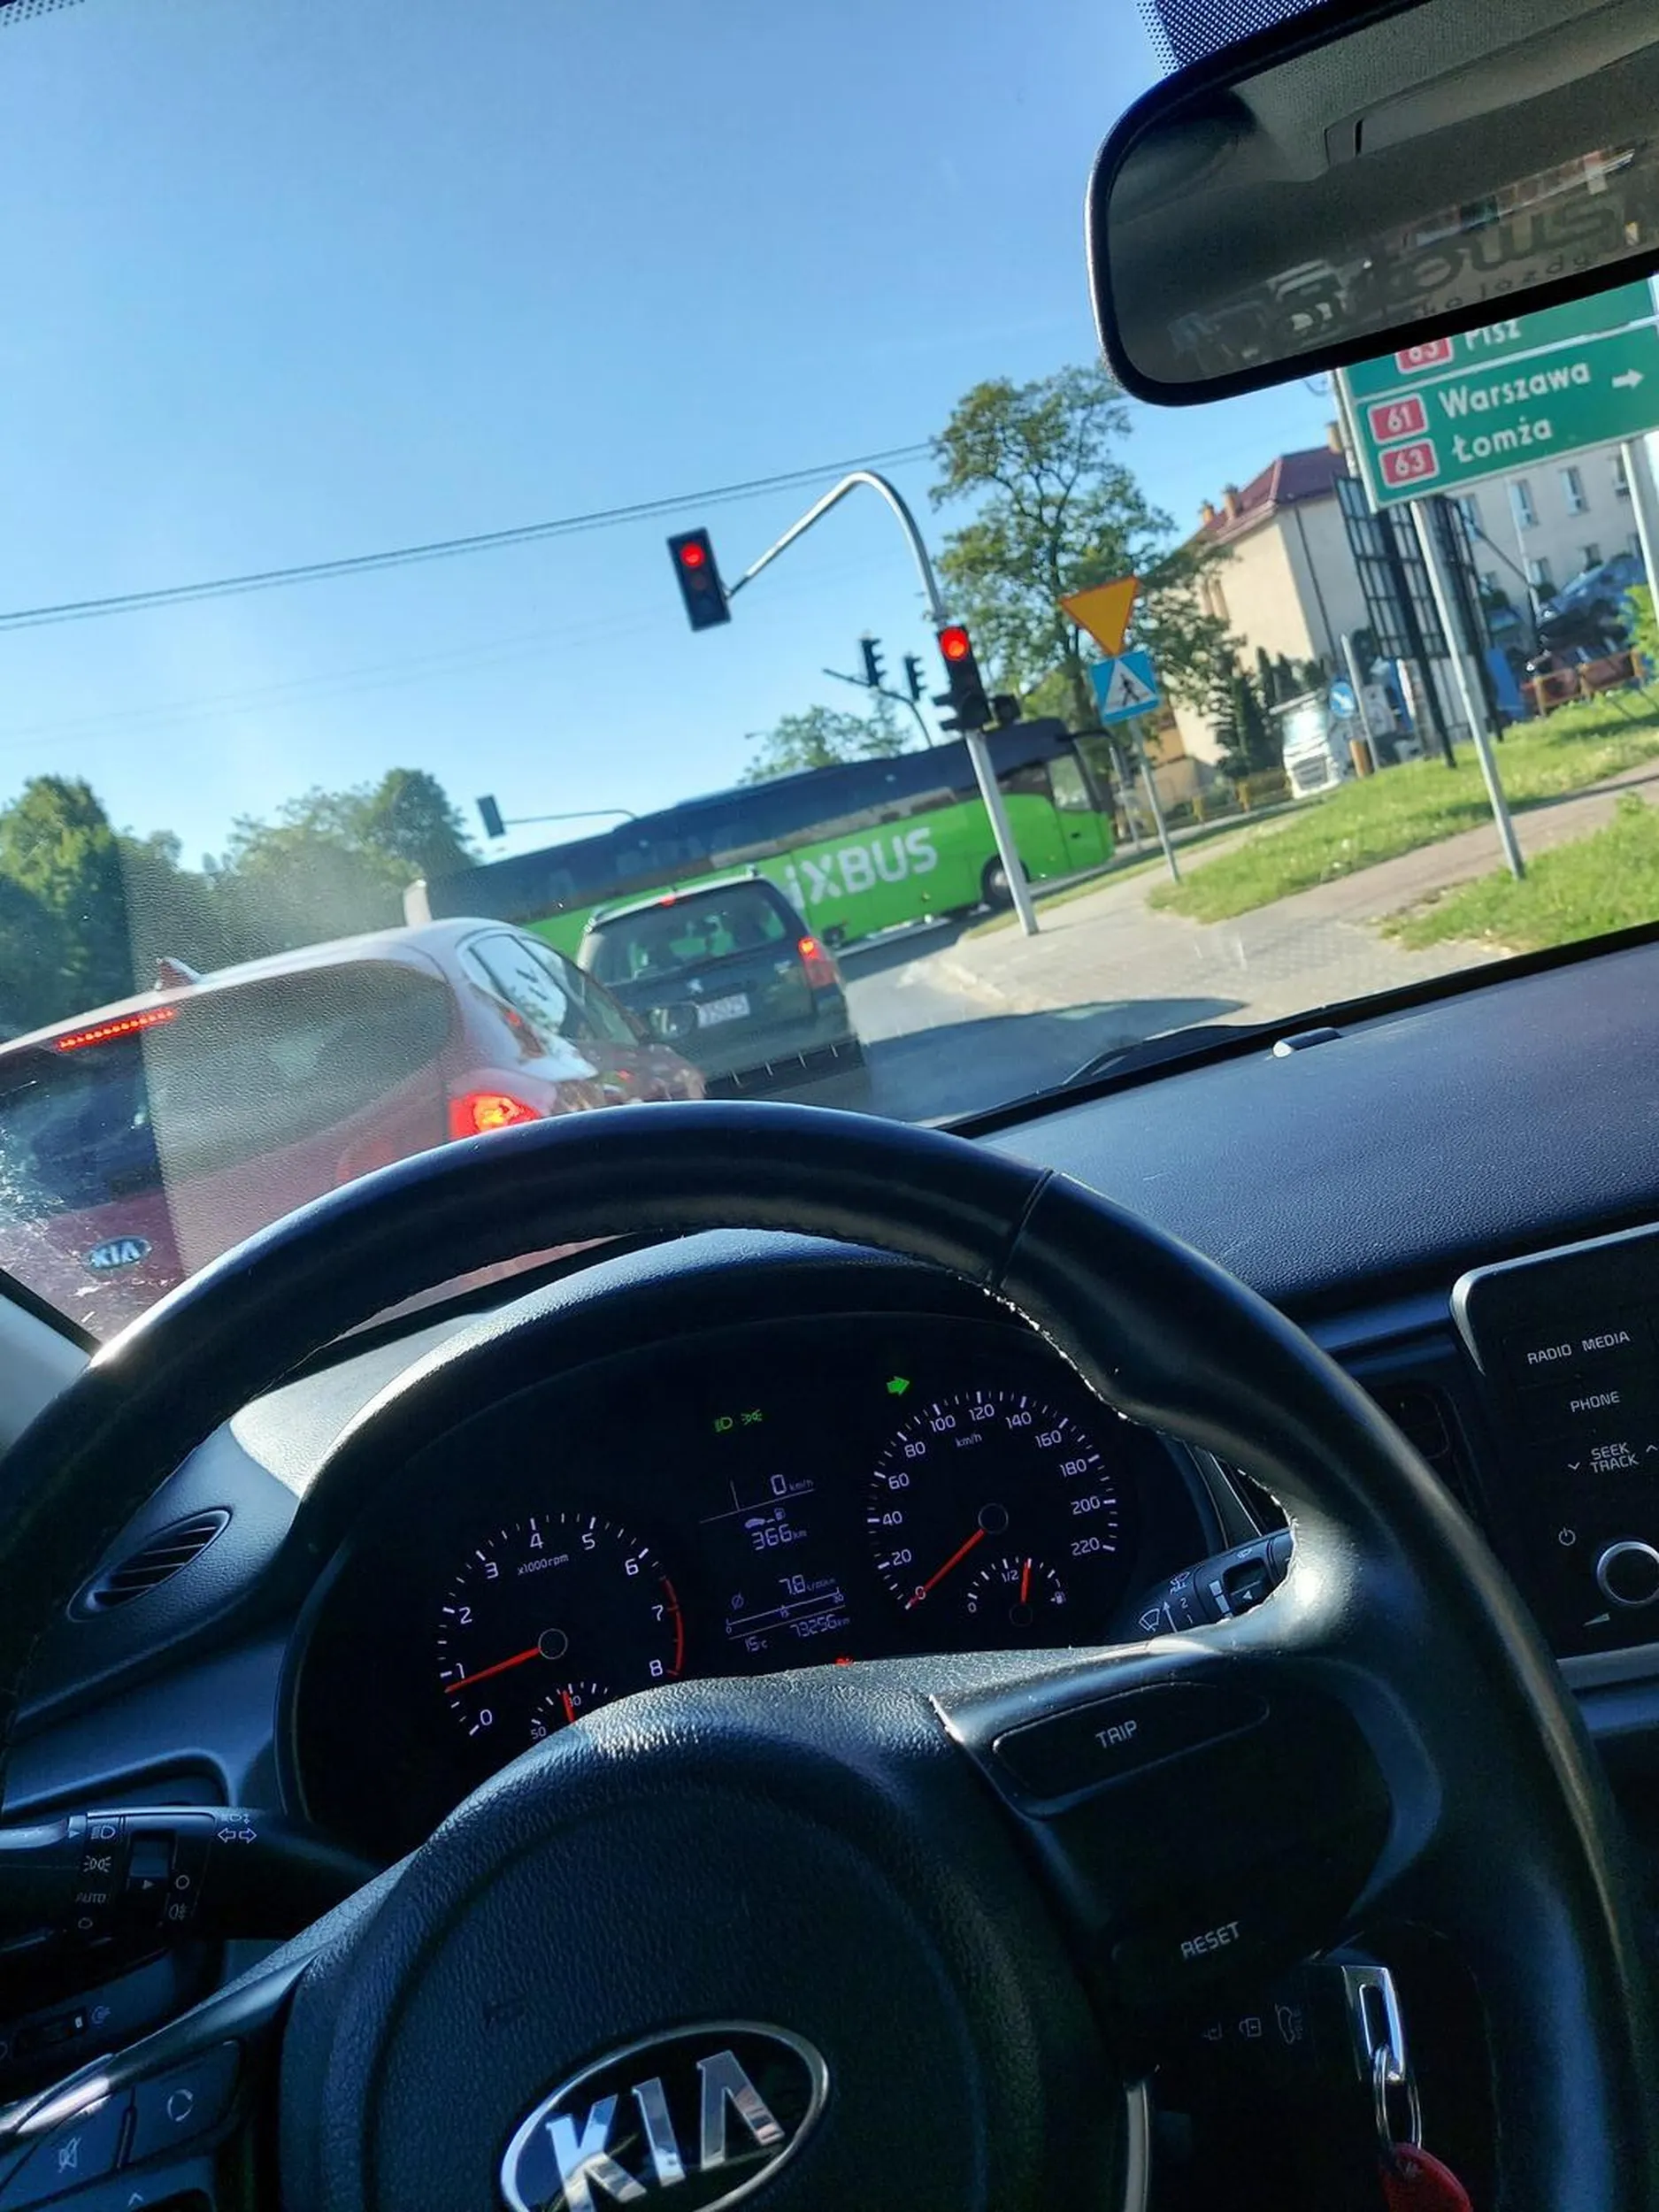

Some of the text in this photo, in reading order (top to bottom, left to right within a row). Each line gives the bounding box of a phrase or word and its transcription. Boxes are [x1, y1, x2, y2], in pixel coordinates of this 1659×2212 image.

[1386, 362, 1591, 432] 61 Warszawa
[1394, 416, 1553, 475] 63 Łomża
[785, 826, 938, 910] iXBUS
[90, 1240, 142, 1268] KIA
[1527, 1330, 1631, 1365] RADIO MEDIA
[1570, 1390, 1621, 1413] PHONE
[969, 1403, 995, 1422] 120
[1005, 1412, 1033, 1430] 140
[930, 1414, 956, 1432] 100
[956, 1432, 983, 1448] km/h
[1035, 1430, 1063, 1448] 160
[904, 1441, 926, 1458] 80
[1591, 1441, 1630, 1461] SEEK
[1059, 1458, 1087, 1478] 180
[1590, 1453, 1640, 1474] TRACK
[770, 1473, 787, 1495] 0
[888, 1472, 910, 1490] 60
[1071, 1495, 1102, 1515] 200
[882, 1510, 903, 1526] 40
[530, 1532, 544, 1549] 4
[581, 1532, 596, 1551] 5
[751, 1523, 793, 1551] 366
[1071, 1536, 1101, 1556] 220
[892, 1548, 913, 1567] 20
[485, 1562, 499, 1579] 3
[625, 1558, 640, 1576] 6
[1002, 1569, 1019, 1583] 1/2
[458, 1607, 472, 1624] 2
[651, 1604, 664, 1622] 7
[967, 1602, 977, 1613] 0
[456, 1663, 465, 1680] 1
[649, 1659, 664, 1677] 8
[480, 1709, 493, 1726] 0
[531, 1726, 548, 1740] 50
[1095, 1720, 1138, 1749] TRIP
[75, 1892, 107, 1904] AUTO
[1180, 1921, 1240, 1960] RESET
[545, 2049, 786, 2212] KIA
